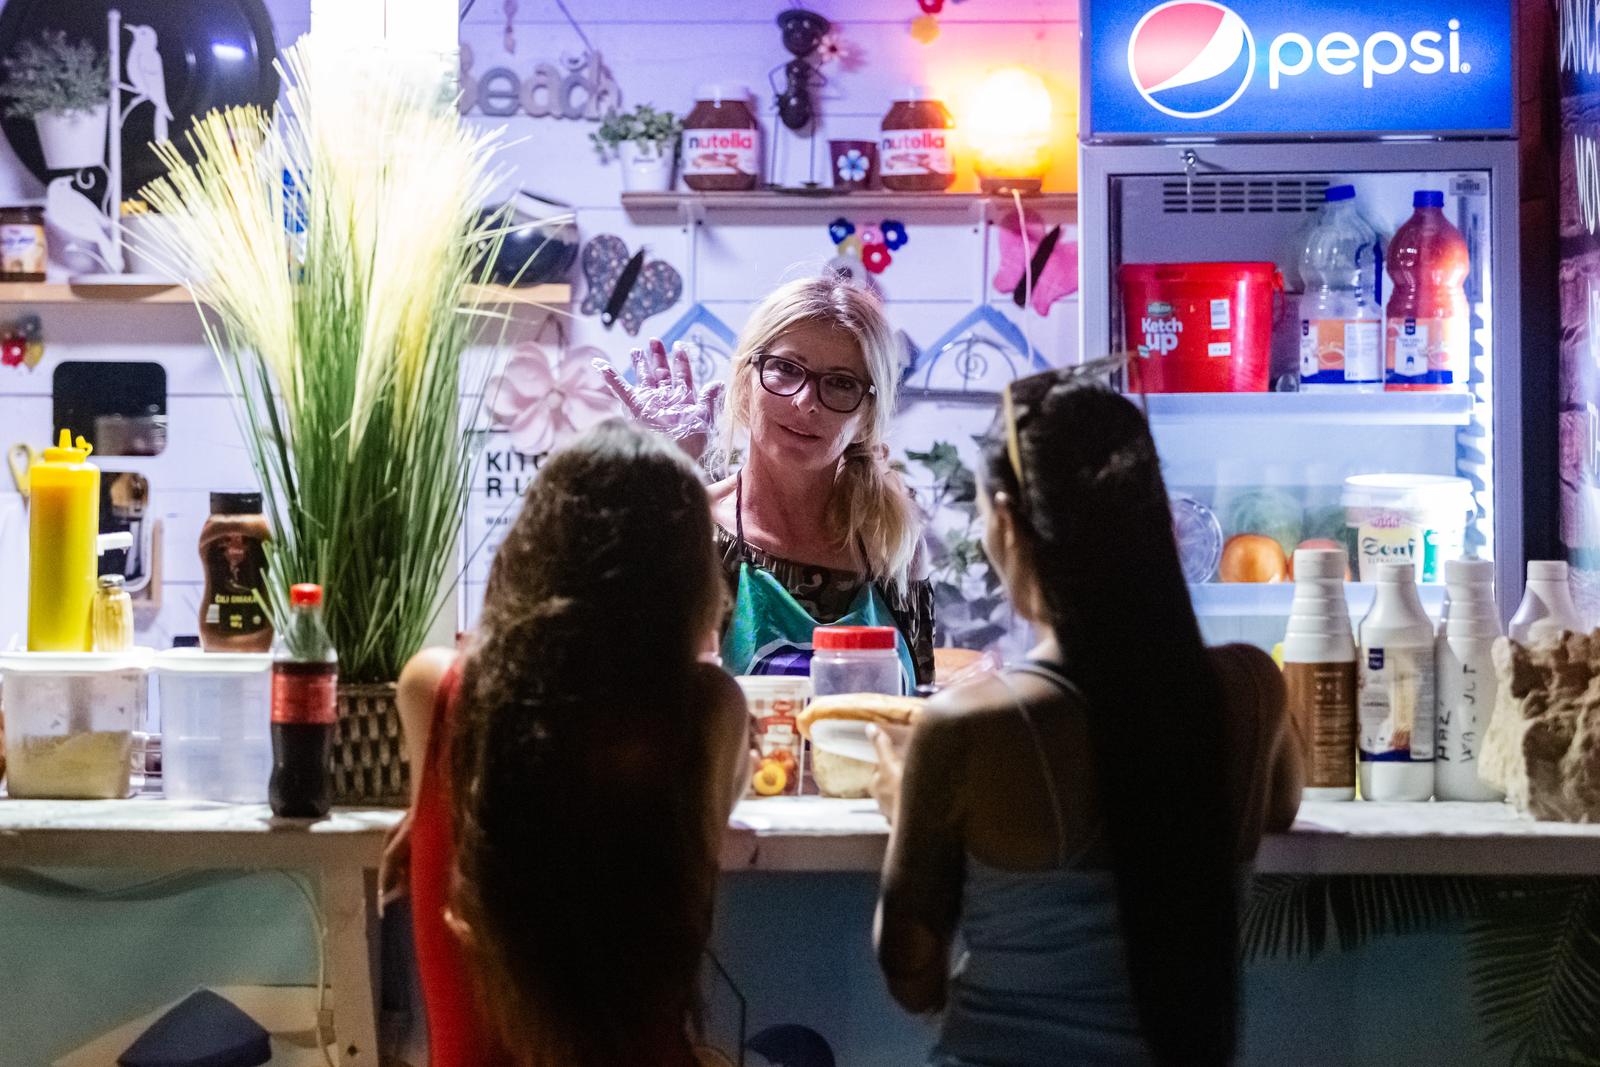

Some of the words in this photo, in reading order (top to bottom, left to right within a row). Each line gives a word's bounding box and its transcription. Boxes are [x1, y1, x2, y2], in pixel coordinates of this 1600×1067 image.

[1268, 18, 1461, 90] pepsi
[688, 131, 753, 149] nutella
[881, 133, 945, 150] nutella
[1141, 316, 1183, 334] Ketch
[1145, 333, 1179, 356] up
